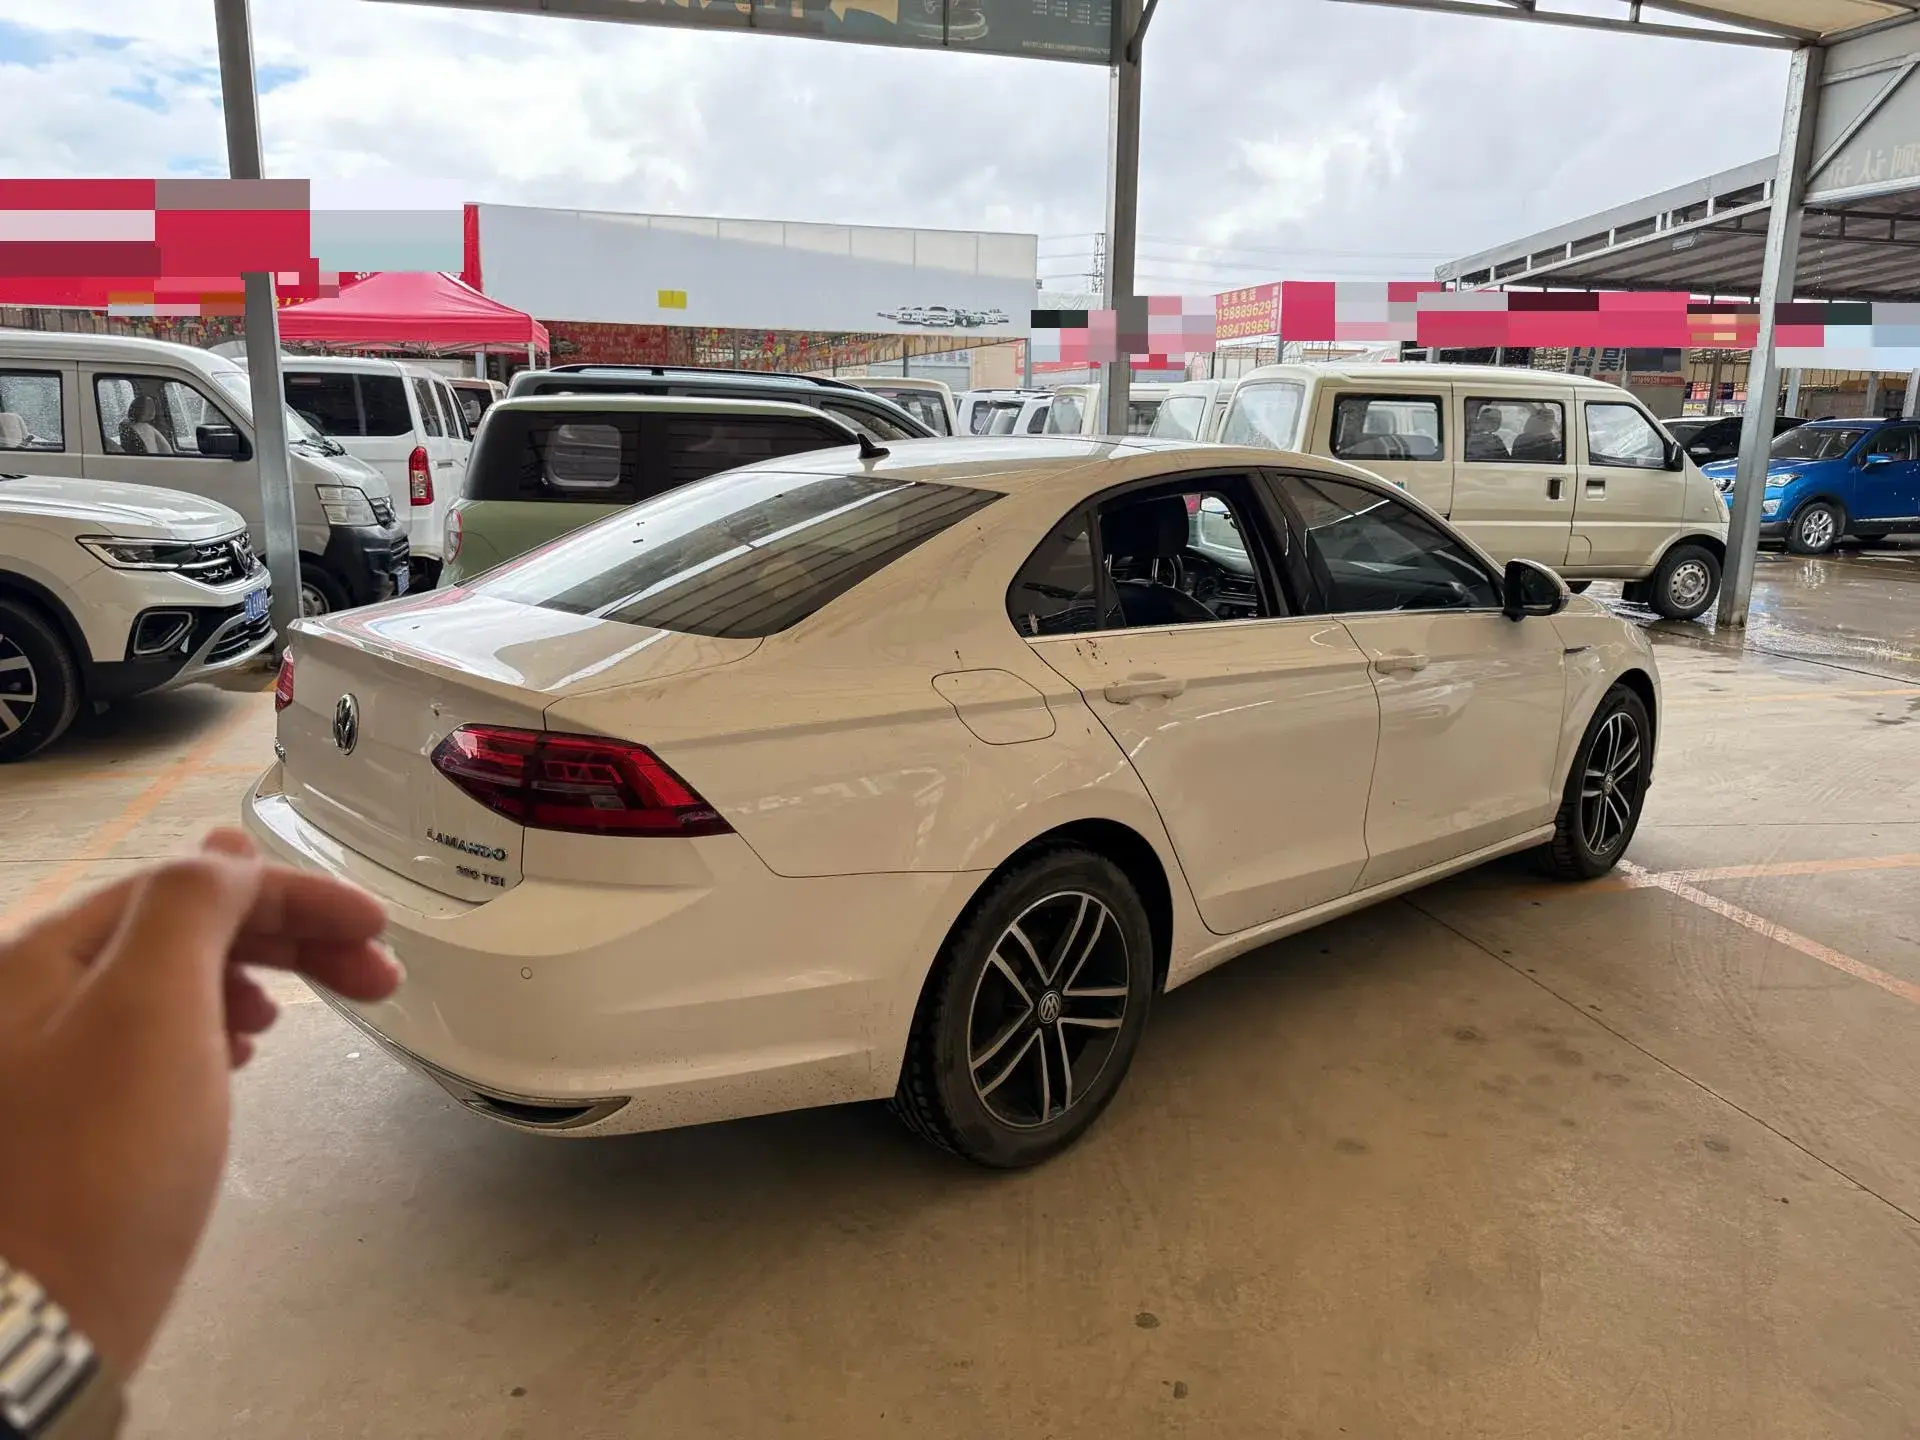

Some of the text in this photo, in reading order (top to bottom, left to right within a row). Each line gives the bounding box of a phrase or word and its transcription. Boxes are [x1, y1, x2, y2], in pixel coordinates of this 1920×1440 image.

[1222, 288, 1257, 305] 联系电话
[426, 828, 508, 861] LAMANDO
[481, 873, 506, 888] TSI
